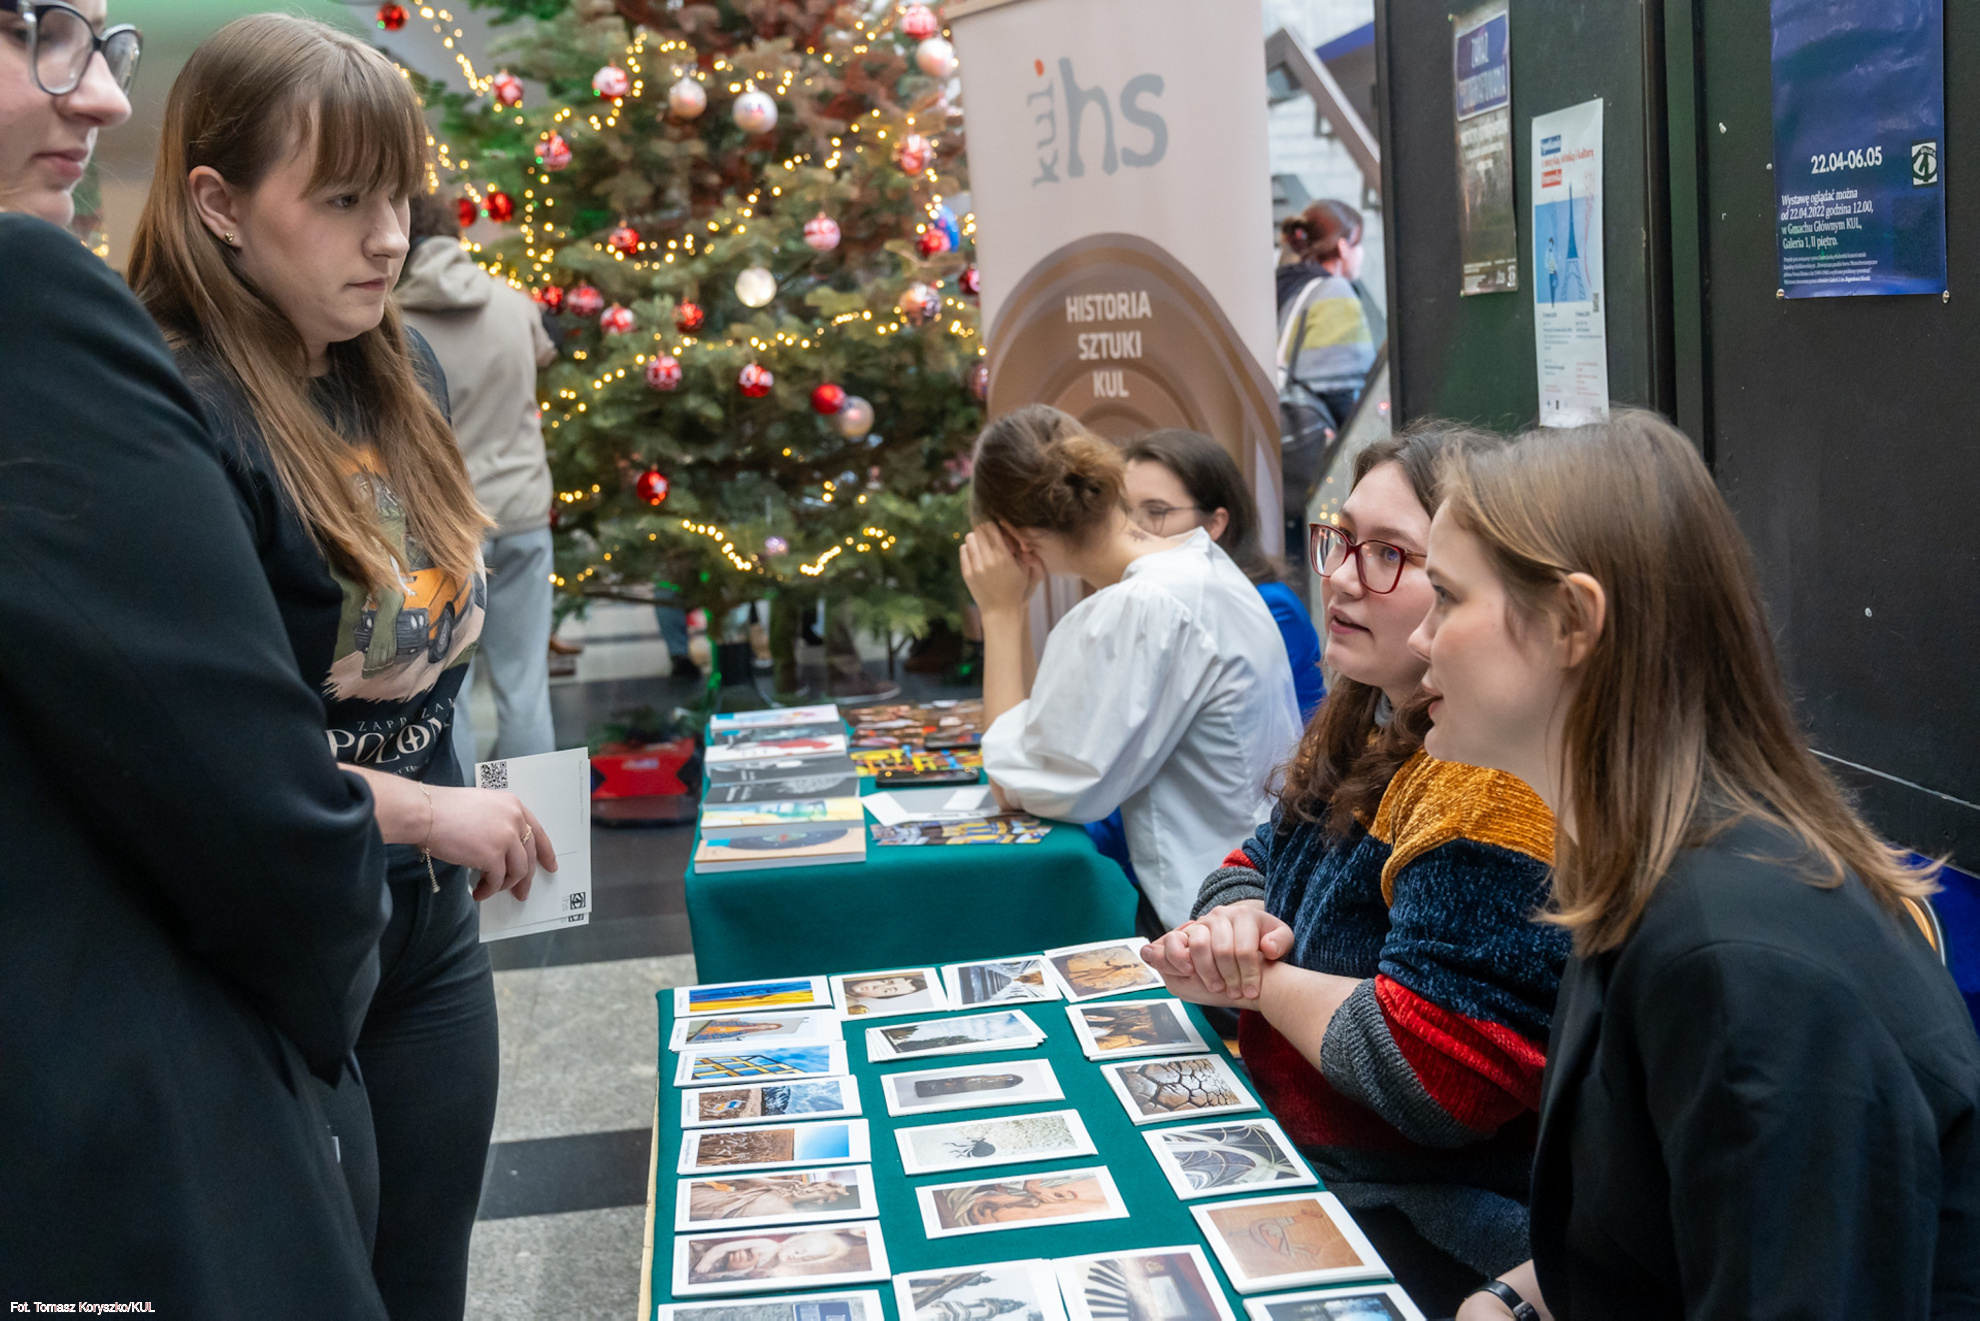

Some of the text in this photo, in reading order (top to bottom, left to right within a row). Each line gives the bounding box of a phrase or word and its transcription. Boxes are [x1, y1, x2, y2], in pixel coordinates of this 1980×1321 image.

[1811, 146, 1883, 174] 22.04-06.05
[1782, 188, 1858, 208] Wystawę oglądać można
[1781, 200, 1874, 221] od 22.04.2022 godzina 12.00,
[1788, 221, 1813, 235] Gmachu
[1814, 220, 1845, 234] Głównym
[1846, 217, 1863, 230] KUL,
[1783, 237, 1805, 250] Galeria
[1817, 235, 1838, 251] piętro.
[1066, 291, 1152, 323] HISTORIA
[1077, 331, 1142, 360] SZTUKI
[1093, 370, 1130, 398] KUL
